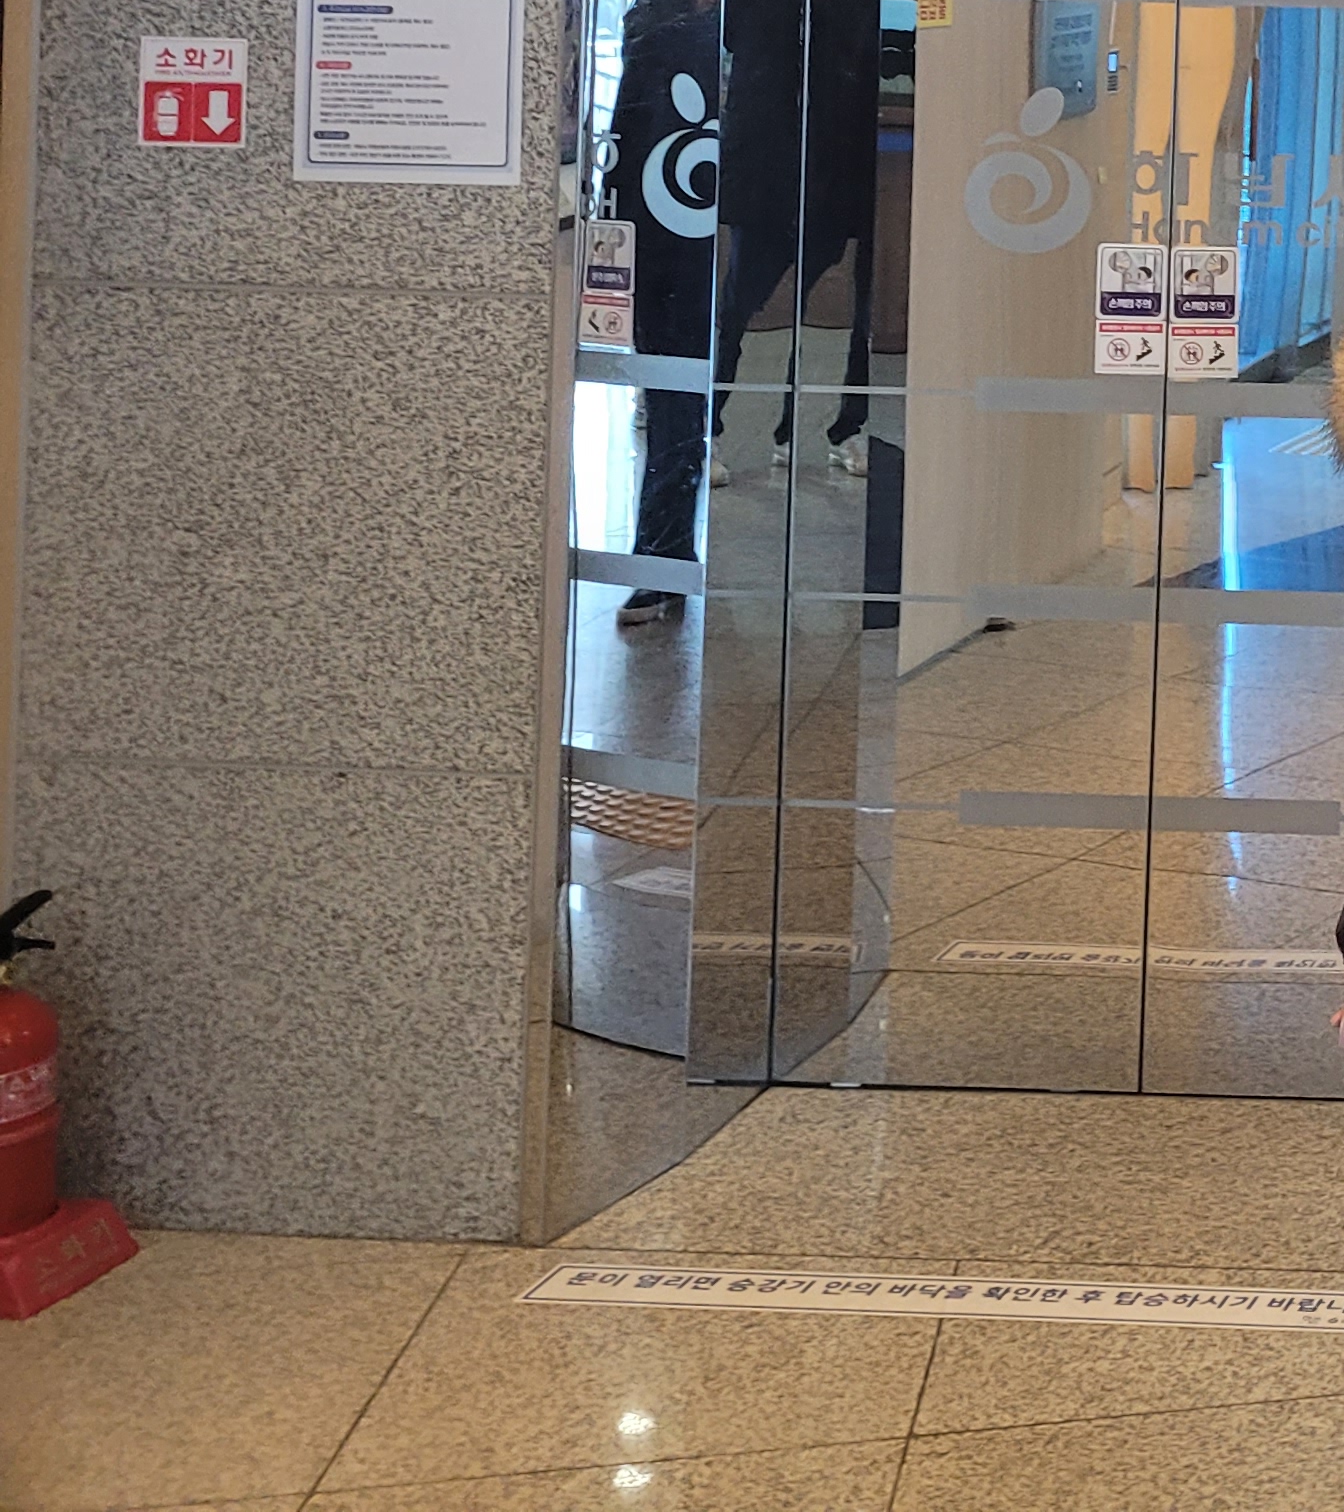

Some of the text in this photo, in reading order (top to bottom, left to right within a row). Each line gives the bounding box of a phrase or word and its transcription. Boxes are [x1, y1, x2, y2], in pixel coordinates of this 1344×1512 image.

[155, 47, 234, 70] 소화기
[566, 1270, 628, 1287] 문이
[1075, 1289, 1112, 1304] 후
[1114, 1291, 1258, 1311] 탑승하시기
